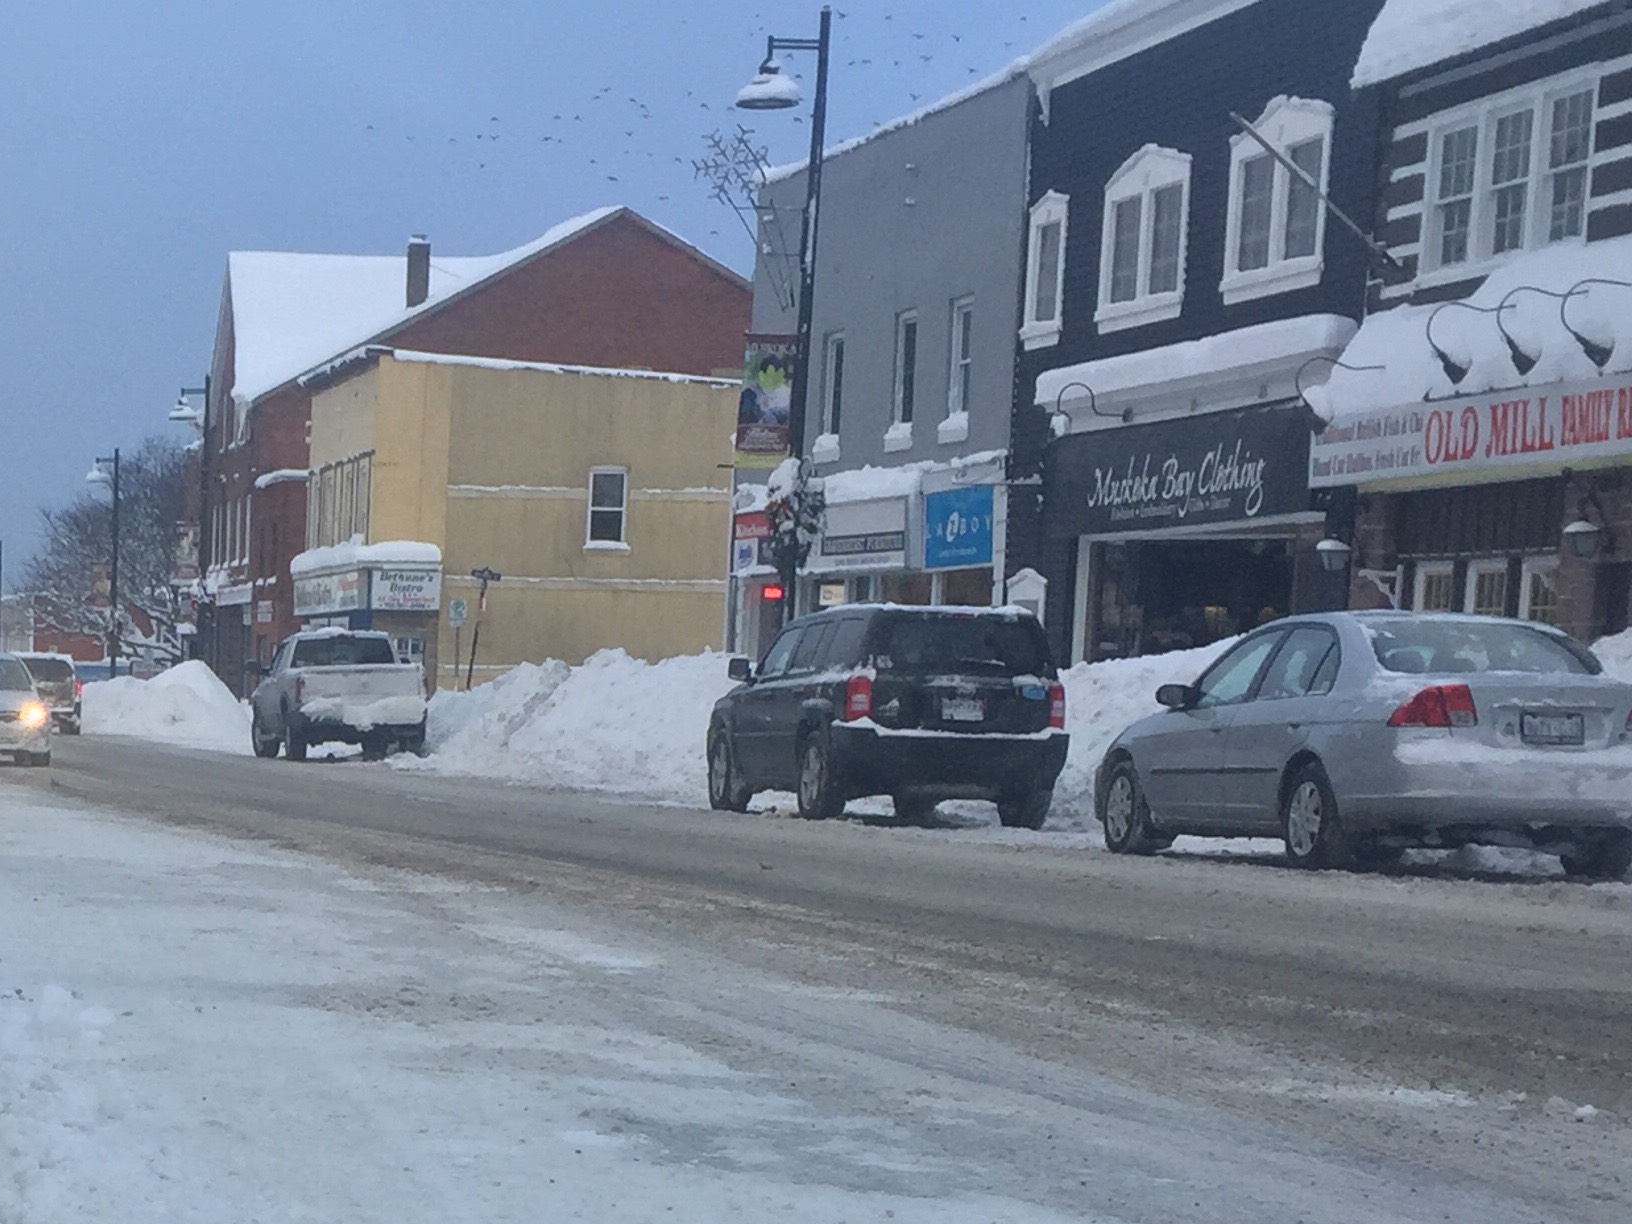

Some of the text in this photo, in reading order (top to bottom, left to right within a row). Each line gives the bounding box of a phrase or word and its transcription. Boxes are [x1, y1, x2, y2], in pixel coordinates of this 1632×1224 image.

[1424, 386, 1632, 464] OLD MILL FAMILY R
[1088, 455, 1158, 507] Muskoka
[1162, 453, 1196, 518] Bay
[1198, 438, 1266, 516] Clothing
